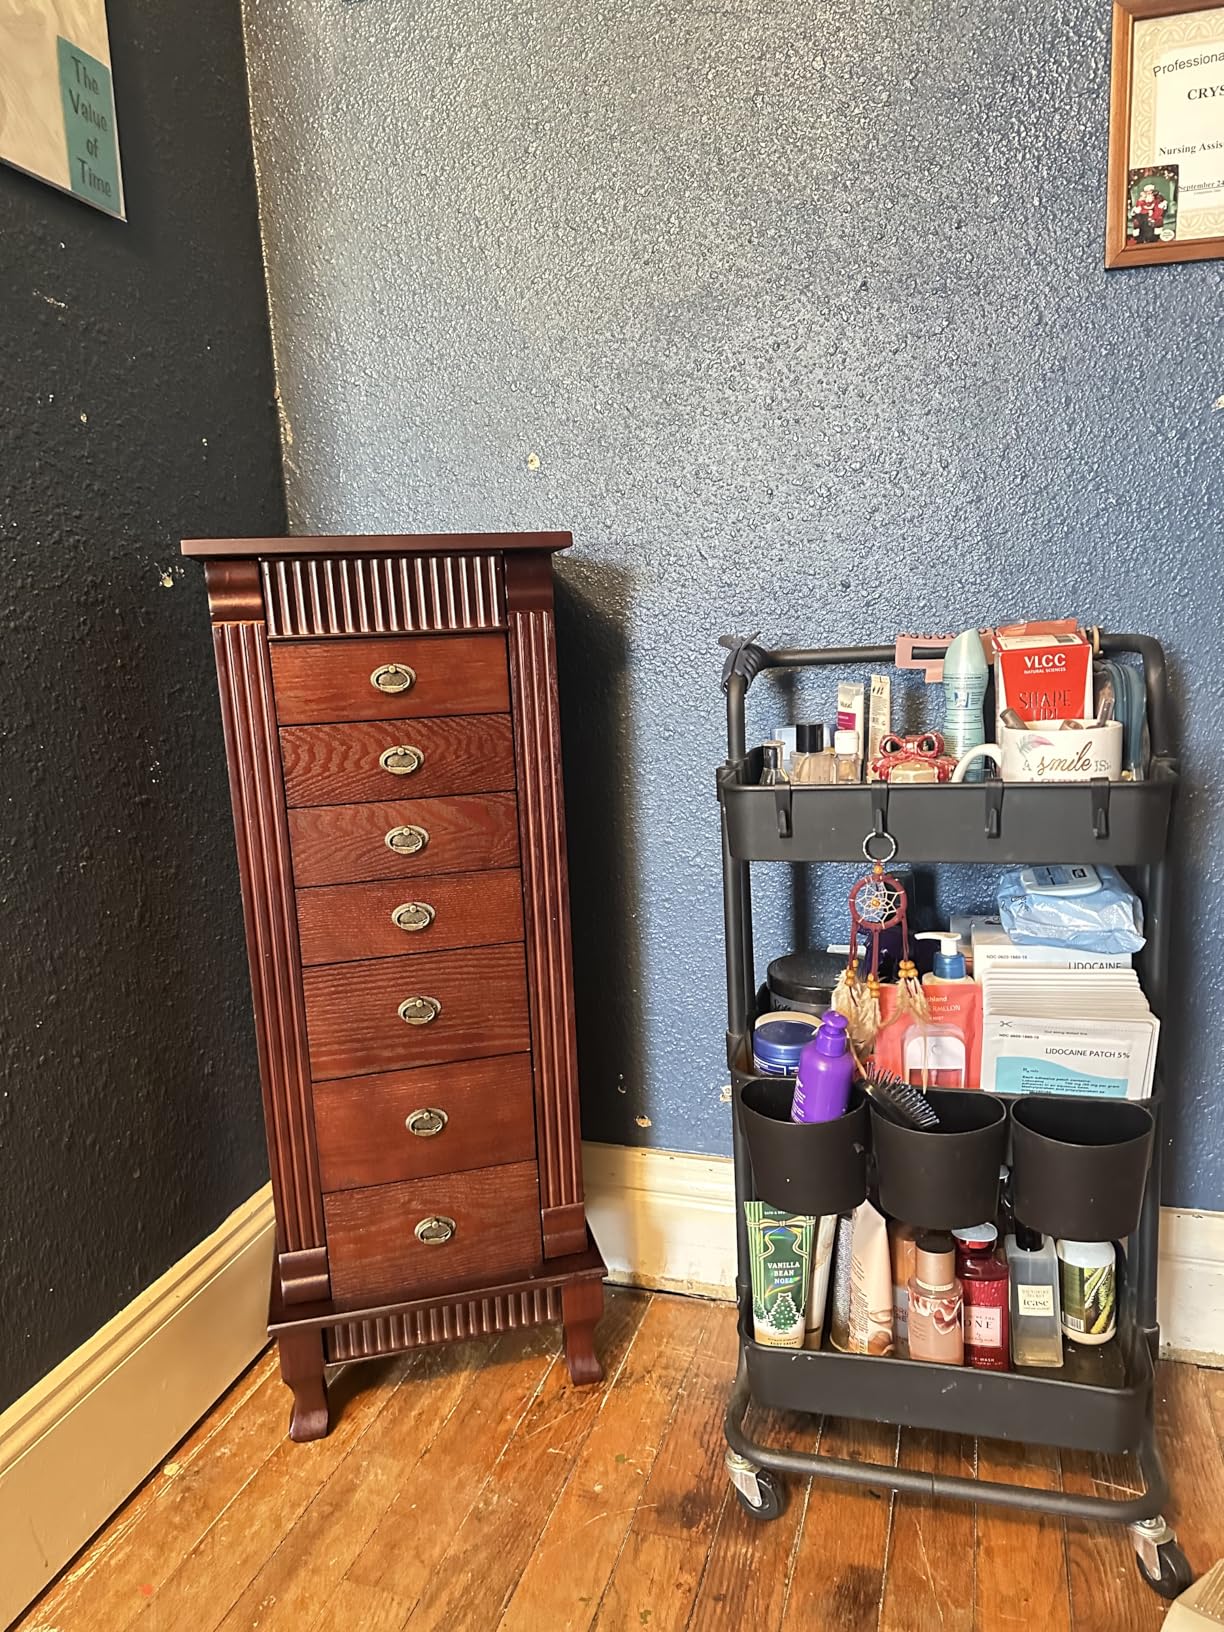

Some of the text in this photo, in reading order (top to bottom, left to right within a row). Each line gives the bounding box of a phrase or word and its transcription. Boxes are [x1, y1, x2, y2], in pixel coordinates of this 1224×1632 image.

[71, 55, 99, 95] The
[69, 88, 108, 132] Value
[86, 137, 99, 158] of
[1159, 144, 1196, 156] Nursing
[77, 157, 112, 198] Time
[1024, 653, 1066, 668] VLCC
[1018, 689, 1072, 710] SHAPE
[1022, 759, 1032, 771] A
[1037, 741, 1093, 776] smile
[1068, 962, 1121, 970] LIDOCAINE
[1045, 1047, 1130, 1059] LIDOCAINE PATCH 5%
[767, 1262, 801, 1270] VANILLA
[773, 1269, 795, 1277] BEAN
[774, 1277, 794, 1285] NOEL
